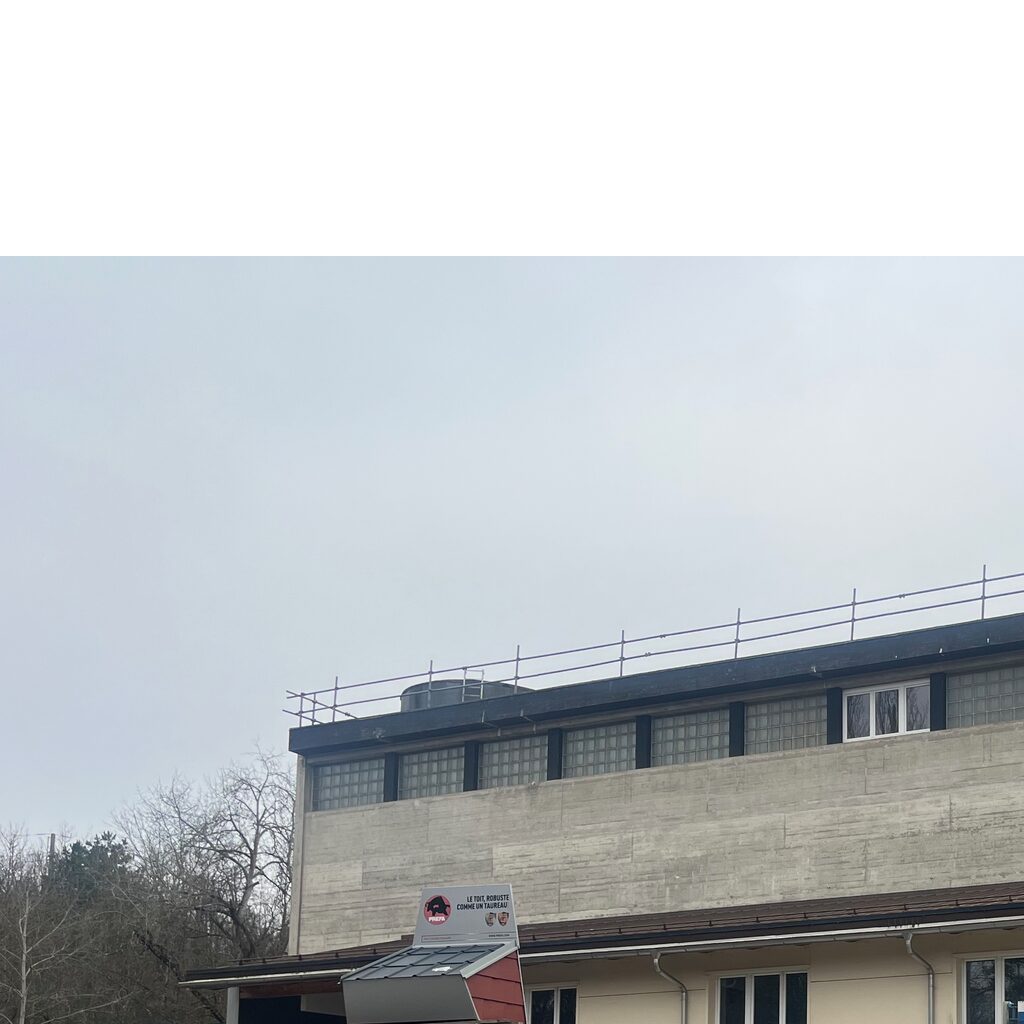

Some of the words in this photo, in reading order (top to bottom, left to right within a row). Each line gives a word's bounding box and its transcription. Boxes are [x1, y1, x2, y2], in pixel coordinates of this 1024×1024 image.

[486, 894, 510, 902] ROBUSTE
[476, 902, 484, 910] UN
[484, 901, 508, 909] TAUREAU
